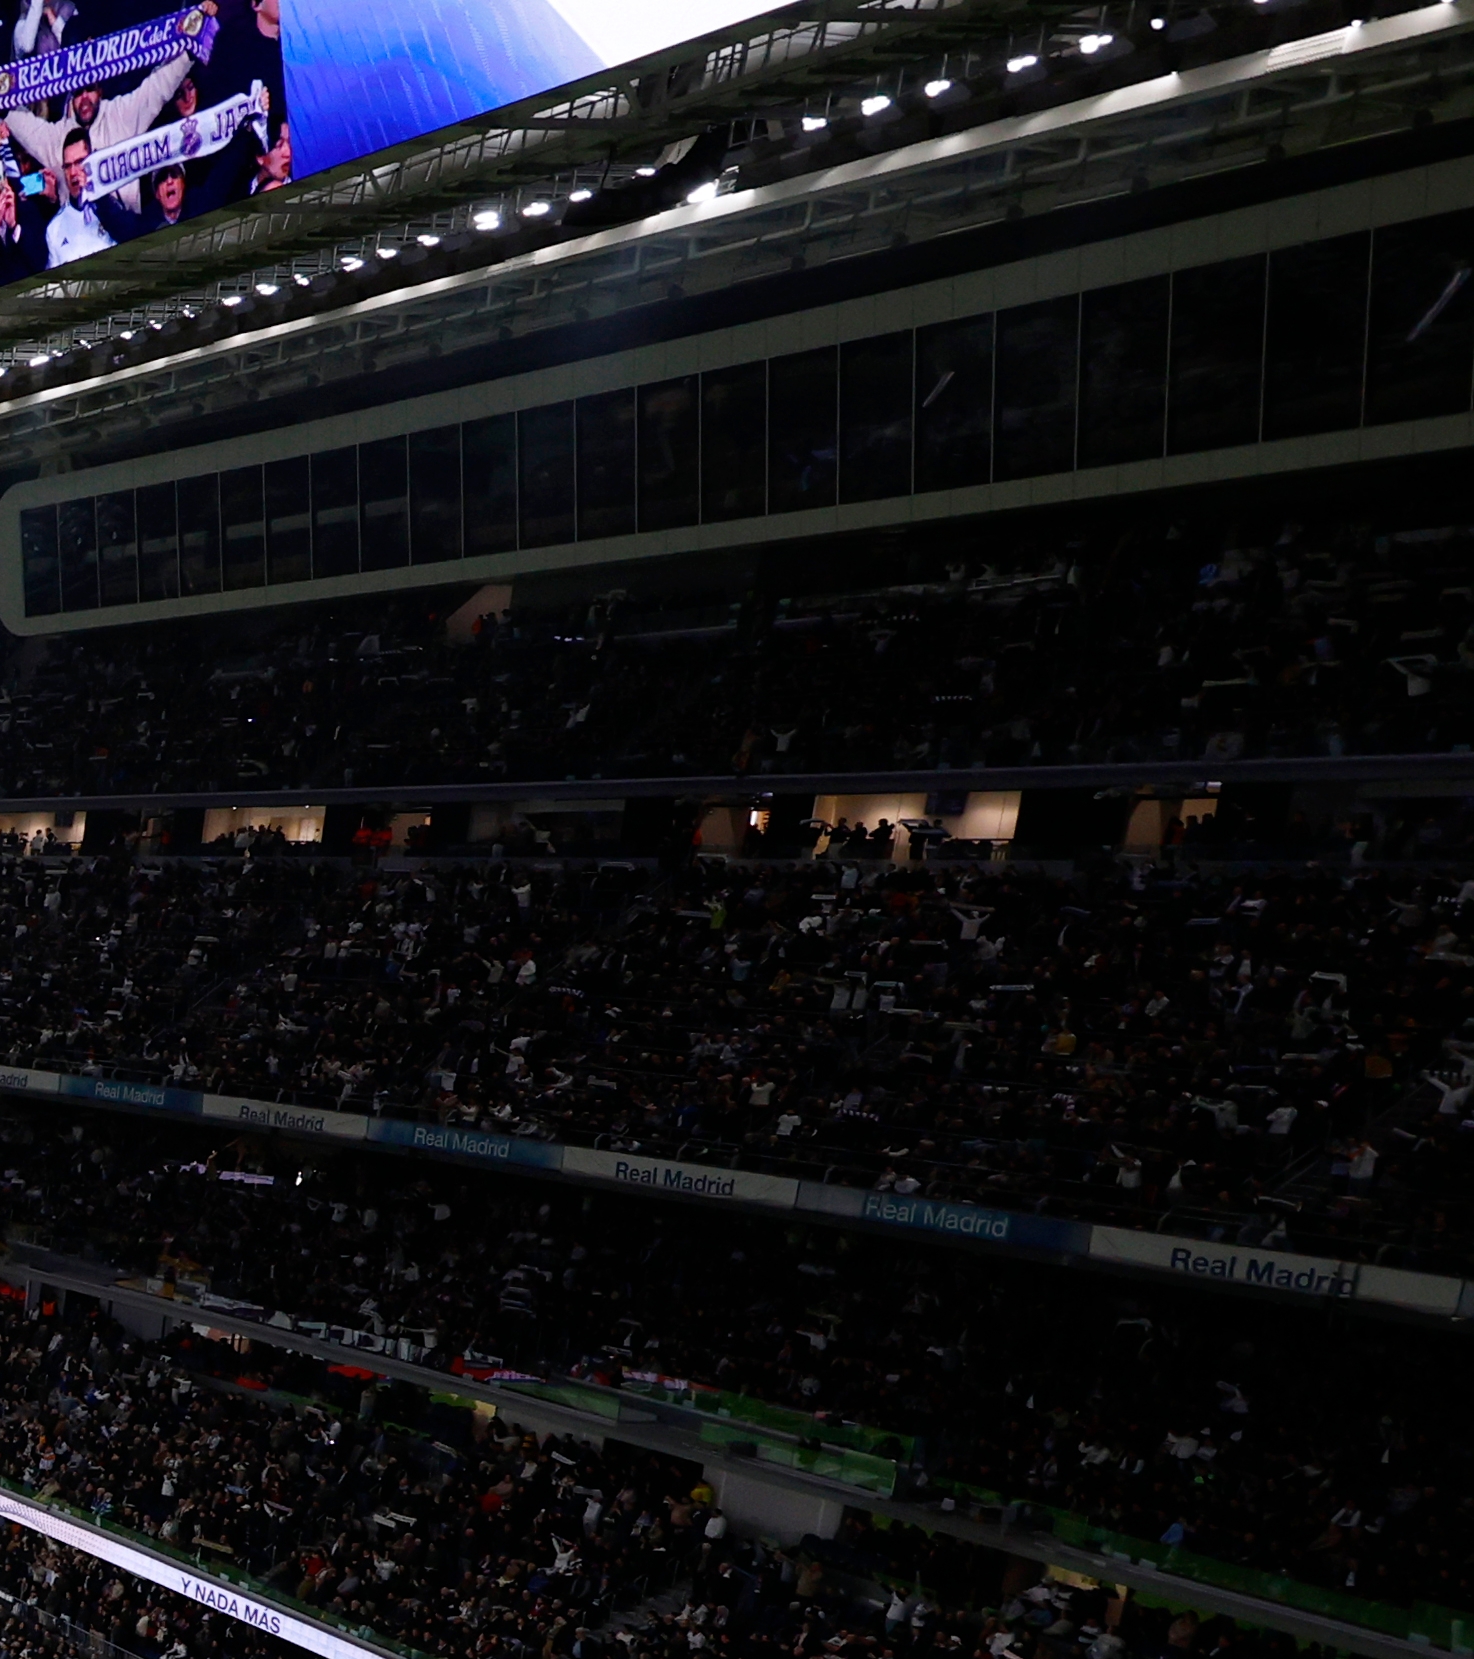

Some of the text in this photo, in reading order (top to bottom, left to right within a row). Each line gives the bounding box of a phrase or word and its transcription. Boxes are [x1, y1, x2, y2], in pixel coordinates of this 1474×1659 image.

[17, 50, 72, 90] REAL
[73, 28, 140, 73] MADRID
[95, 1081, 165, 1106] Real Madrid
[239, 1105, 325, 1132] Real Madrid
[414, 1127, 510, 1158] Real Madrid
[615, 1161, 735, 1197] Real Madrid
[865, 1195, 1009, 1238] Real Madrid
[1171, 1248, 1355, 1298] Real Madrid
[181, 1577, 281, 1634] Y NADA MÁS
